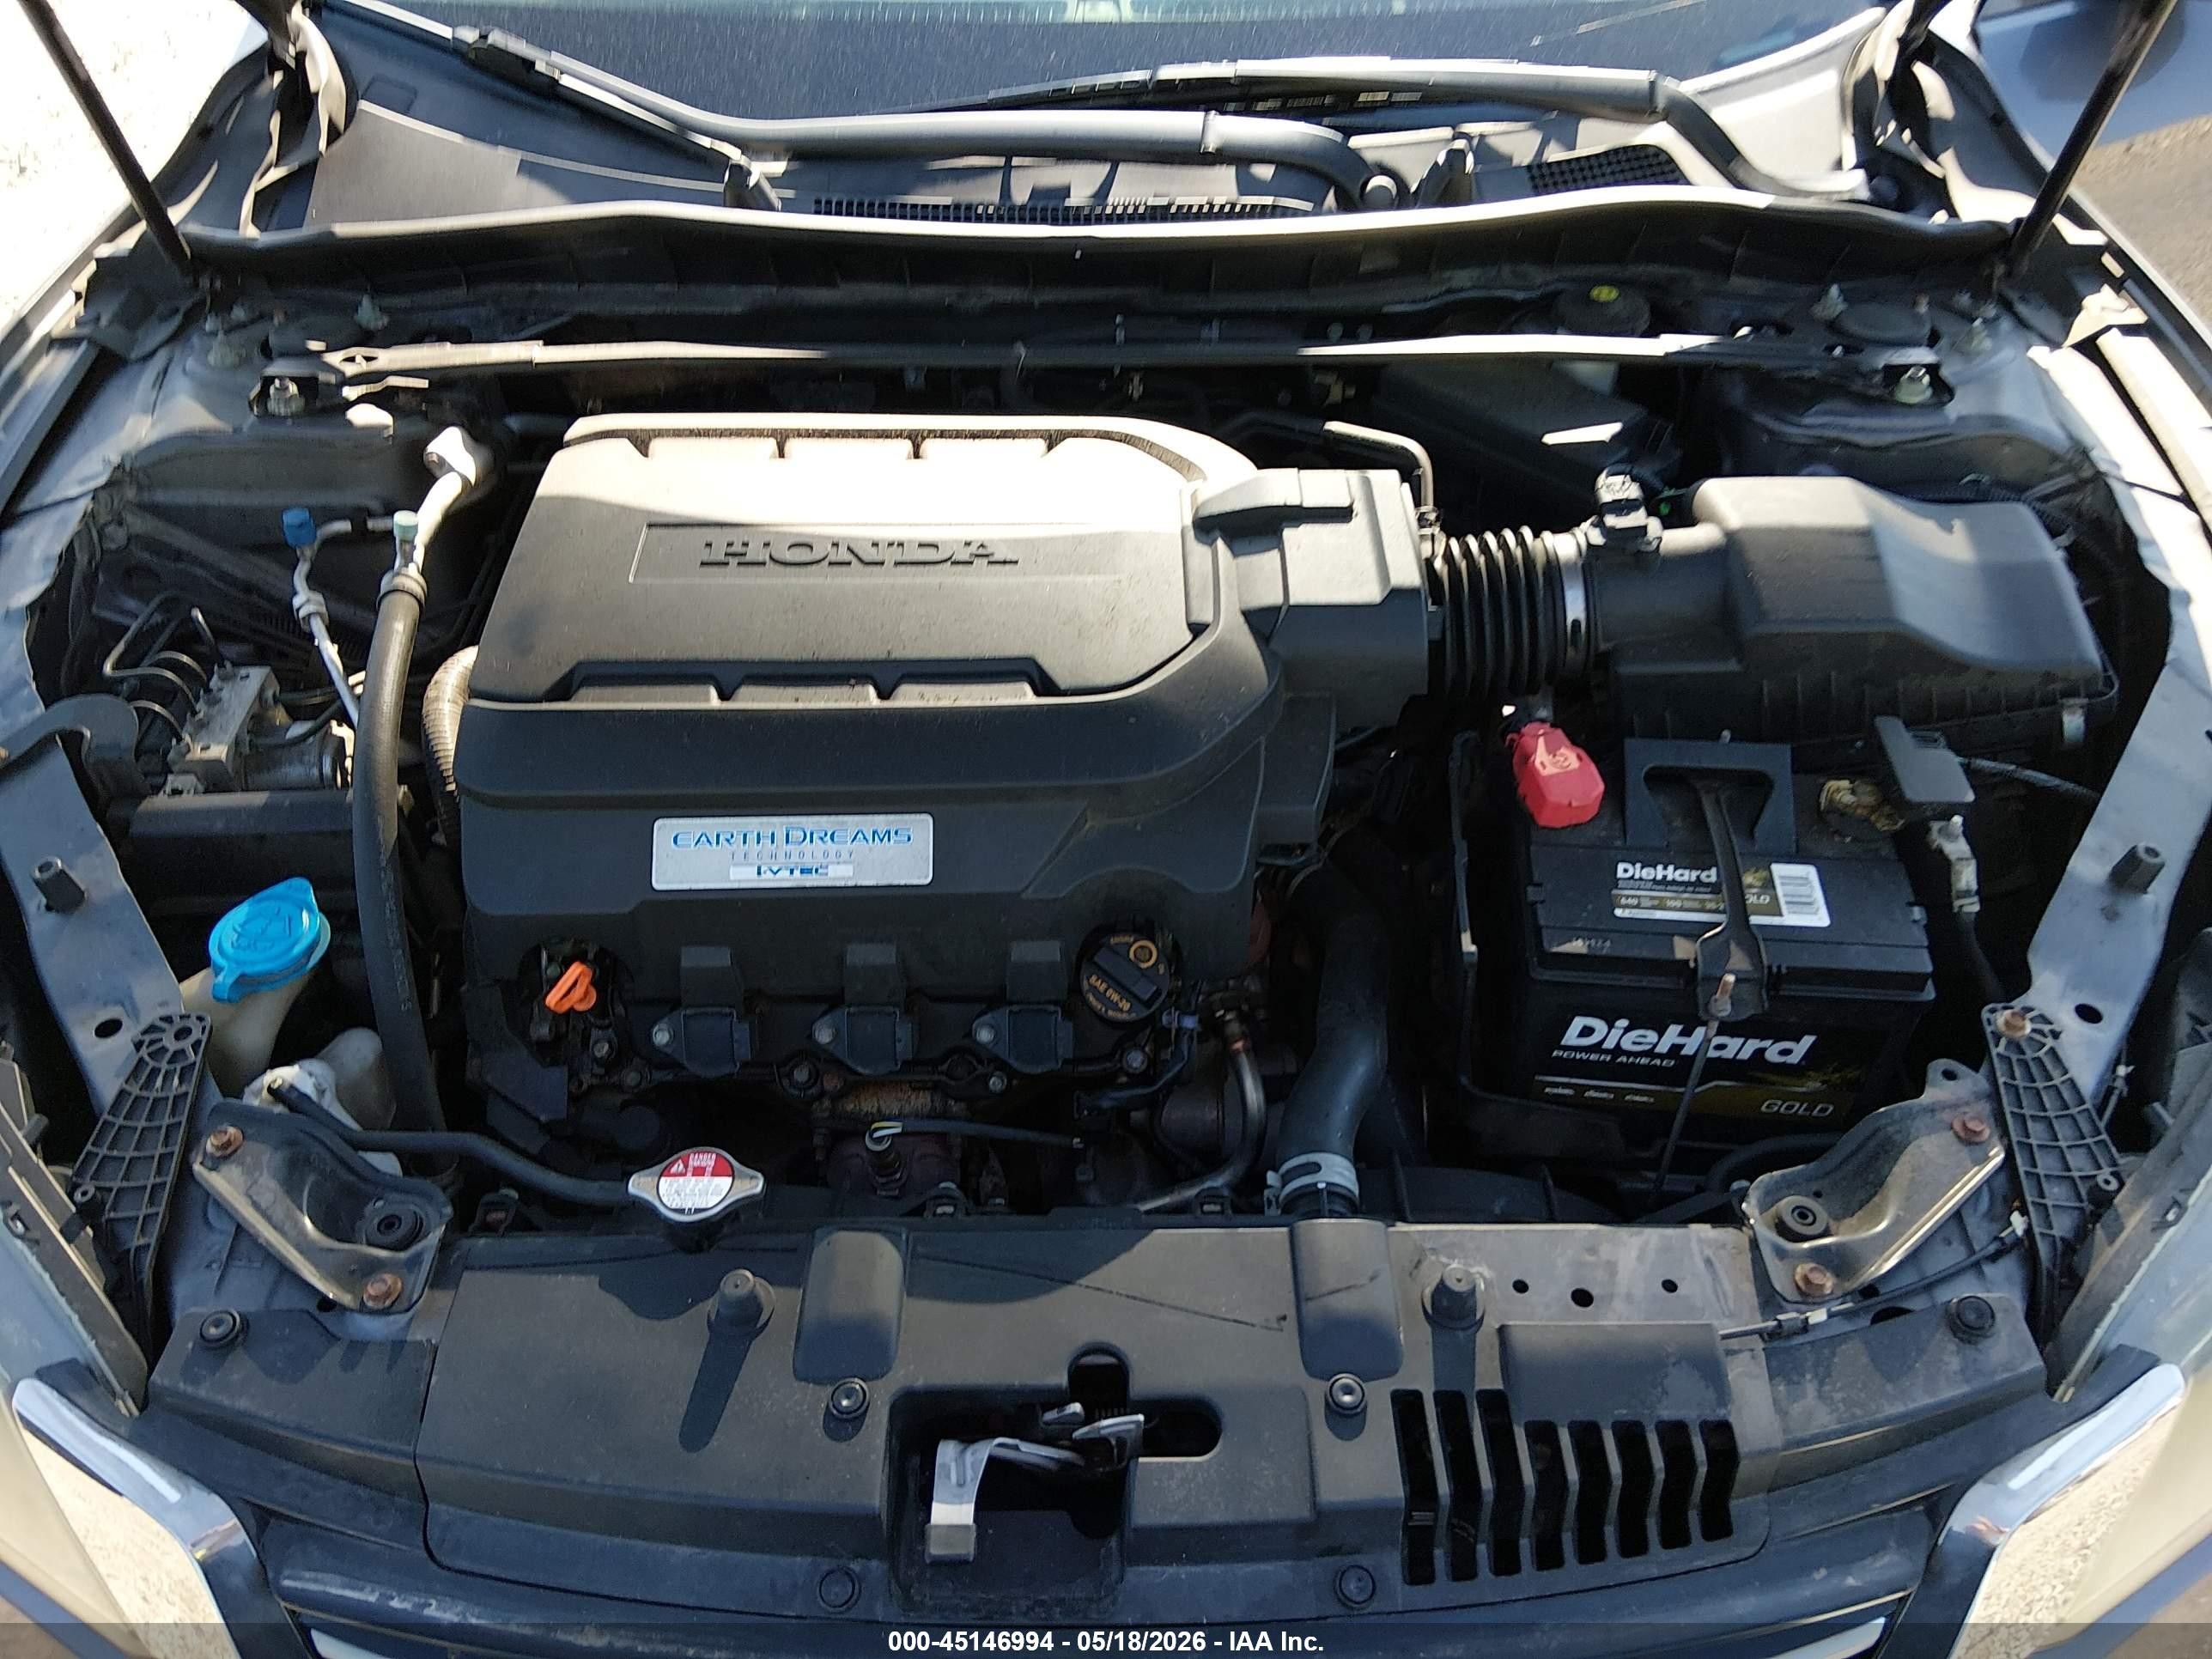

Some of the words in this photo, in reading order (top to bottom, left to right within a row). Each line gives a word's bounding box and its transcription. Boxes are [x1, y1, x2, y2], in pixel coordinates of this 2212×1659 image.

[699, 540, 1020, 567] HONDA
[672, 827, 776, 848] EARTH
[784, 824, 914, 846] DREAMS
[730, 849, 855, 861] TECHNOLOGY
[1616, 861, 1717, 884] DieHard
[1089, 975, 1108, 994] SAE
[1559, 1015, 1819, 1065] DieHard
[1552, 1048, 1612, 1064] POWER
[1616, 1054, 1677, 1068] AHEAD
[1759, 1099, 1836, 1119] GOLD
